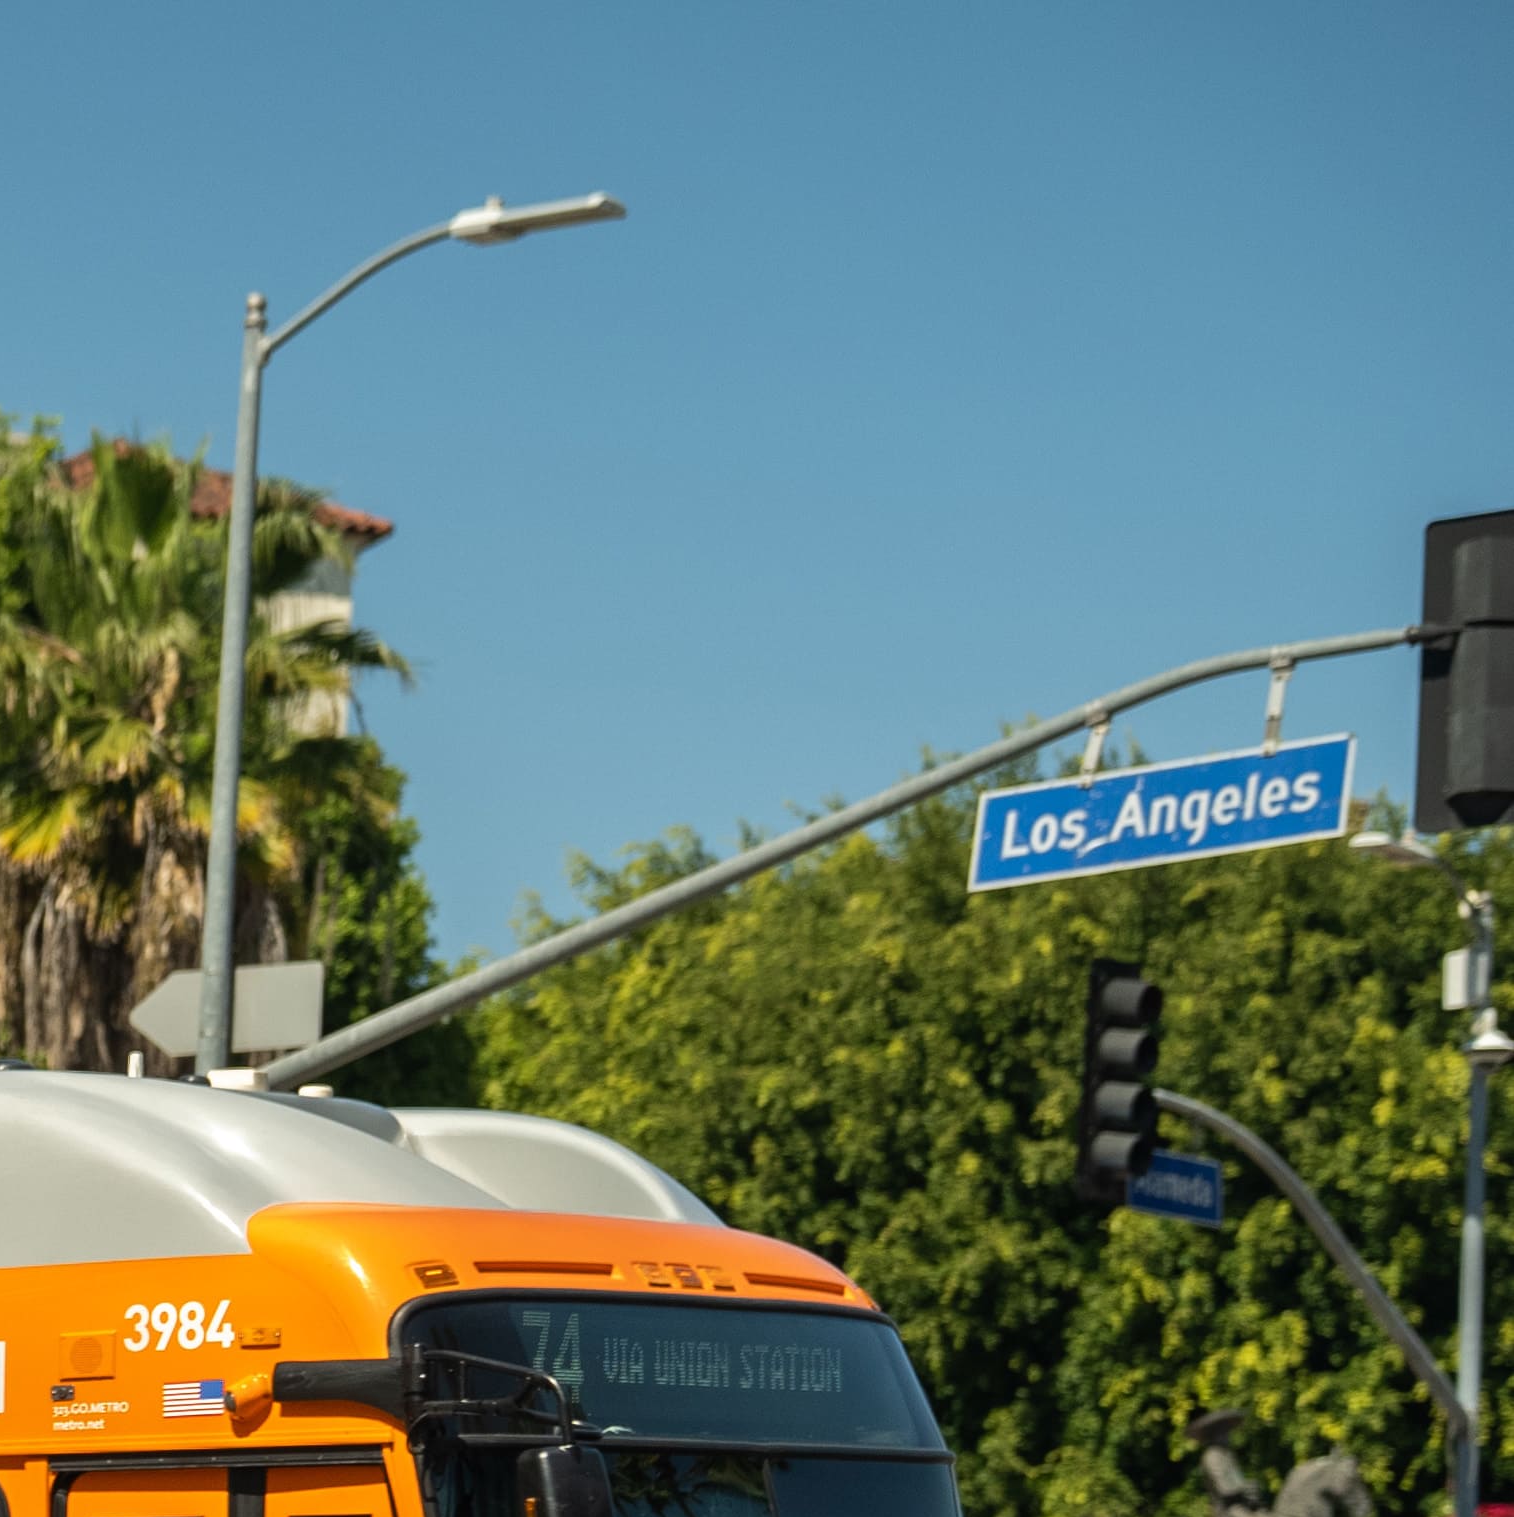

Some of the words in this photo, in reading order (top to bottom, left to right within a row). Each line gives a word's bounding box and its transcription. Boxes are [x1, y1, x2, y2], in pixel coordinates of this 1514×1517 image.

[1000, 808, 1088, 860] Los
[1108, 770, 1322, 846] Angeles
[123, 1300, 235, 1352] 3984
[522, 1310, 584, 1404] 74
[603, 1337, 644, 1384] VIA
[654, 1340, 730, 1388] UNION
[739, 1344, 842, 1393] STATION
